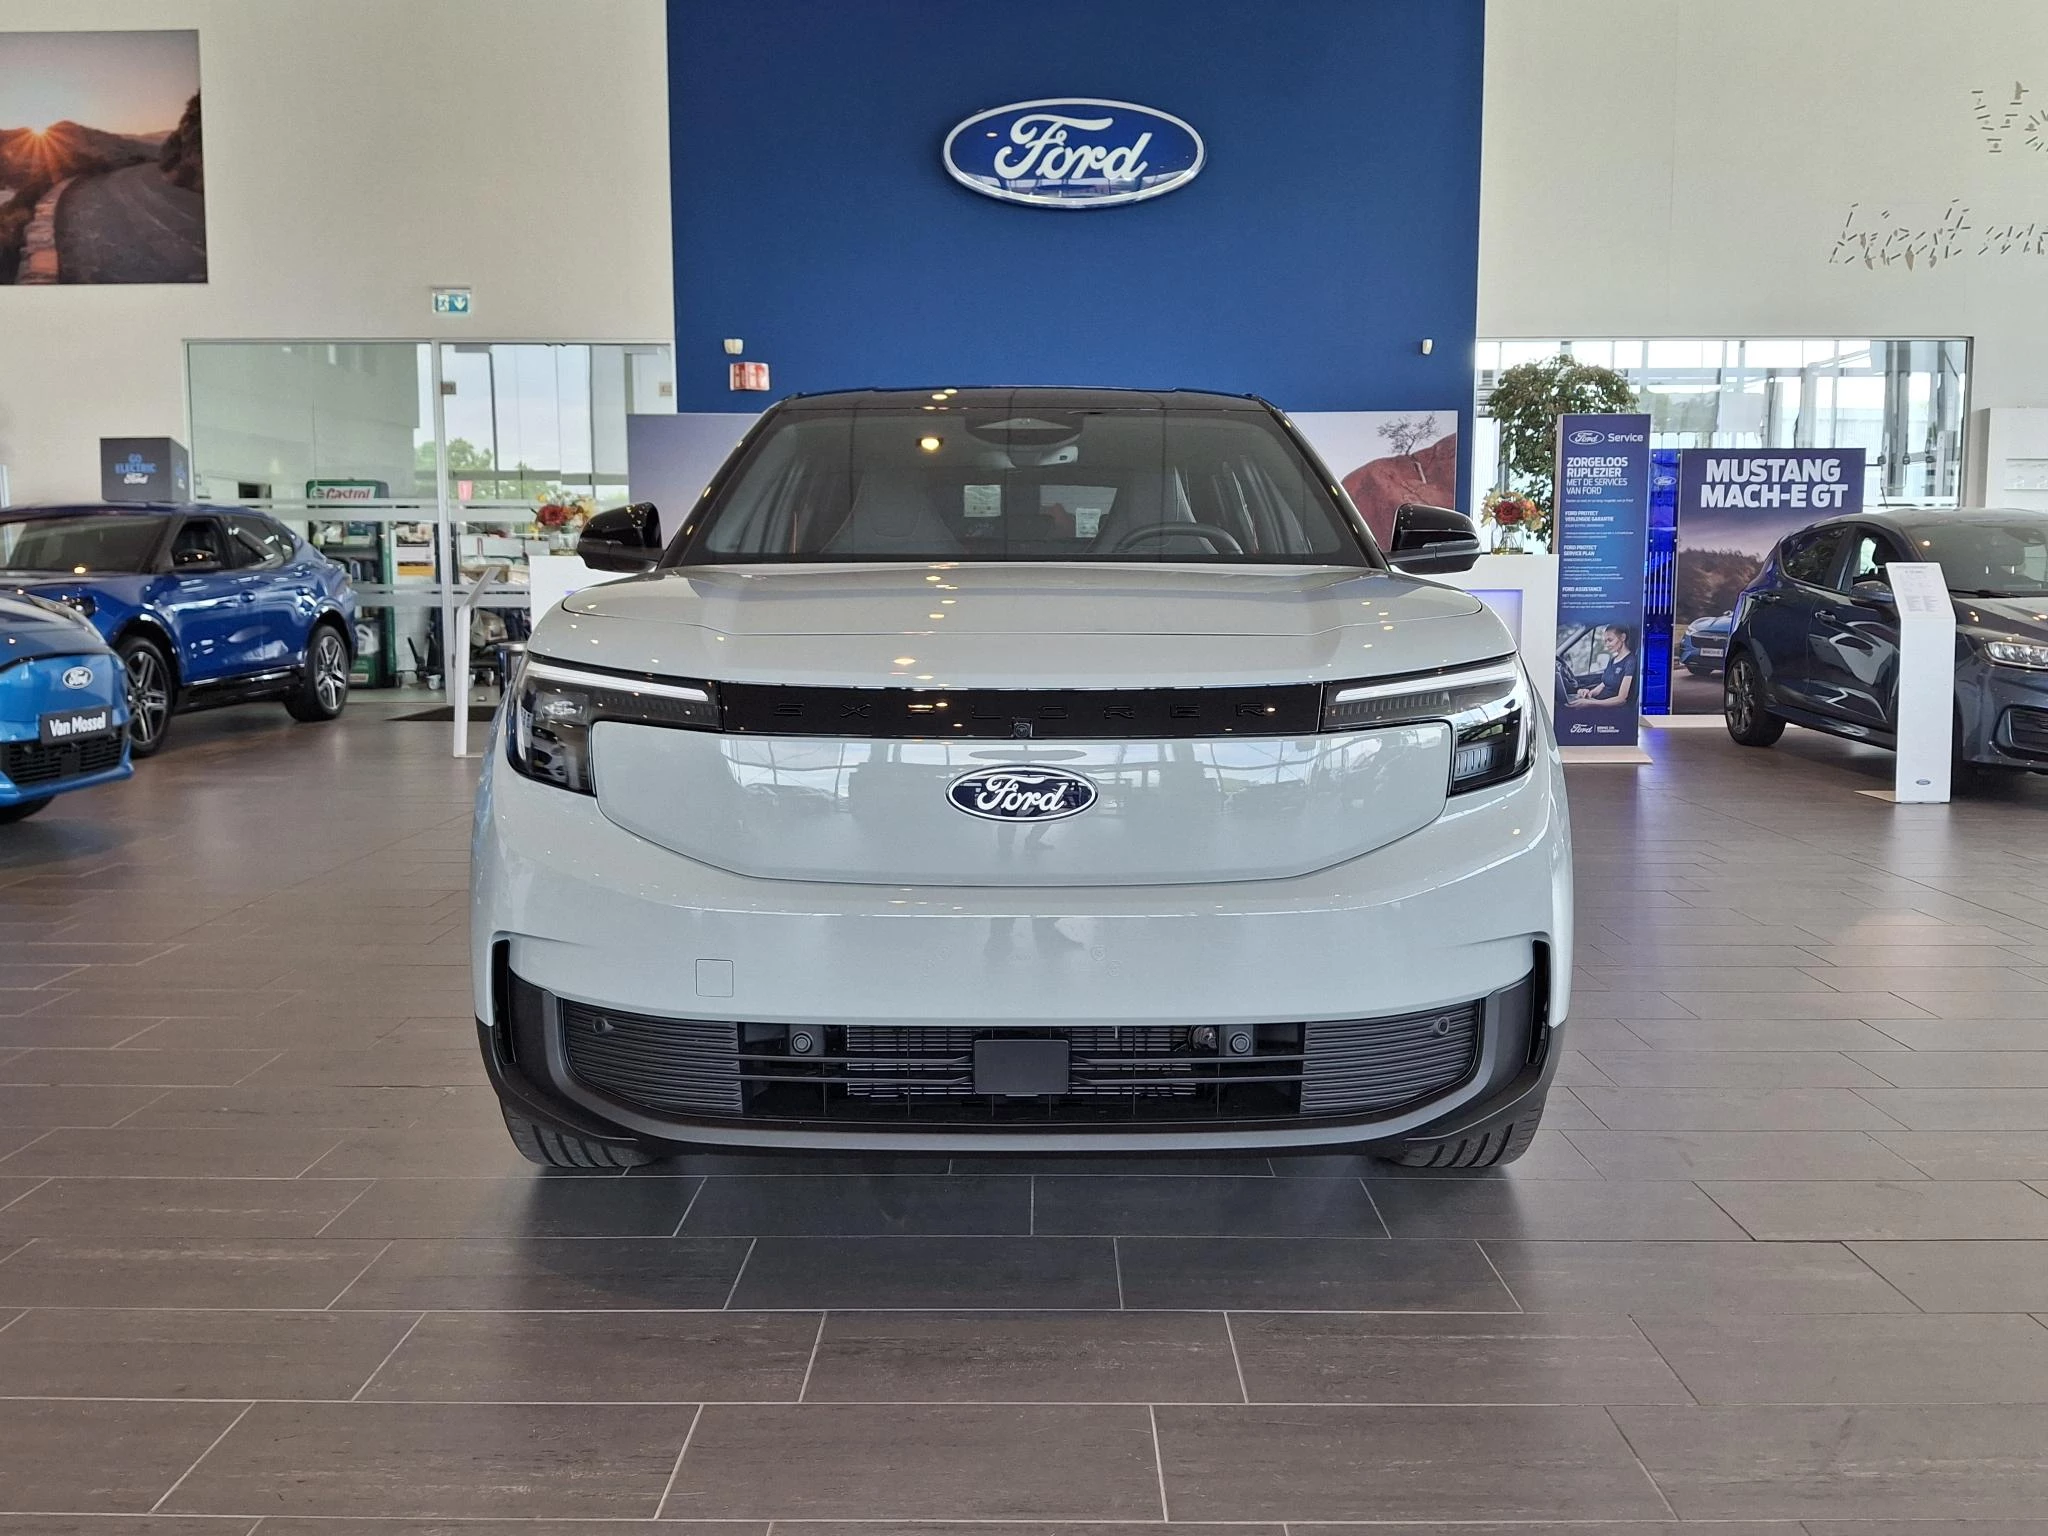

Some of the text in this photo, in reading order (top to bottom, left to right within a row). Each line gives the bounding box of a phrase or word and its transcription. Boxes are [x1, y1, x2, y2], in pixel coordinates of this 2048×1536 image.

[993, 113, 1153, 181] Ford
[1607, 432, 1644, 443] Service
[1566, 456, 1629, 468] ZORGELOOS
[1566, 467, 1622, 478] RIJPLEZIER
[1706, 458, 1841, 483] MUSTANG
[1566, 477, 1628, 487] MET DE SERVICES
[1566, 486, 1602, 495] VAN FORD
[1700, 484, 1849, 508] MACH-E GT
[49, 711, 106, 737] Van Mossel
[1570, 723, 1593, 733] Ford
[976, 773, 1069, 811] Ford
